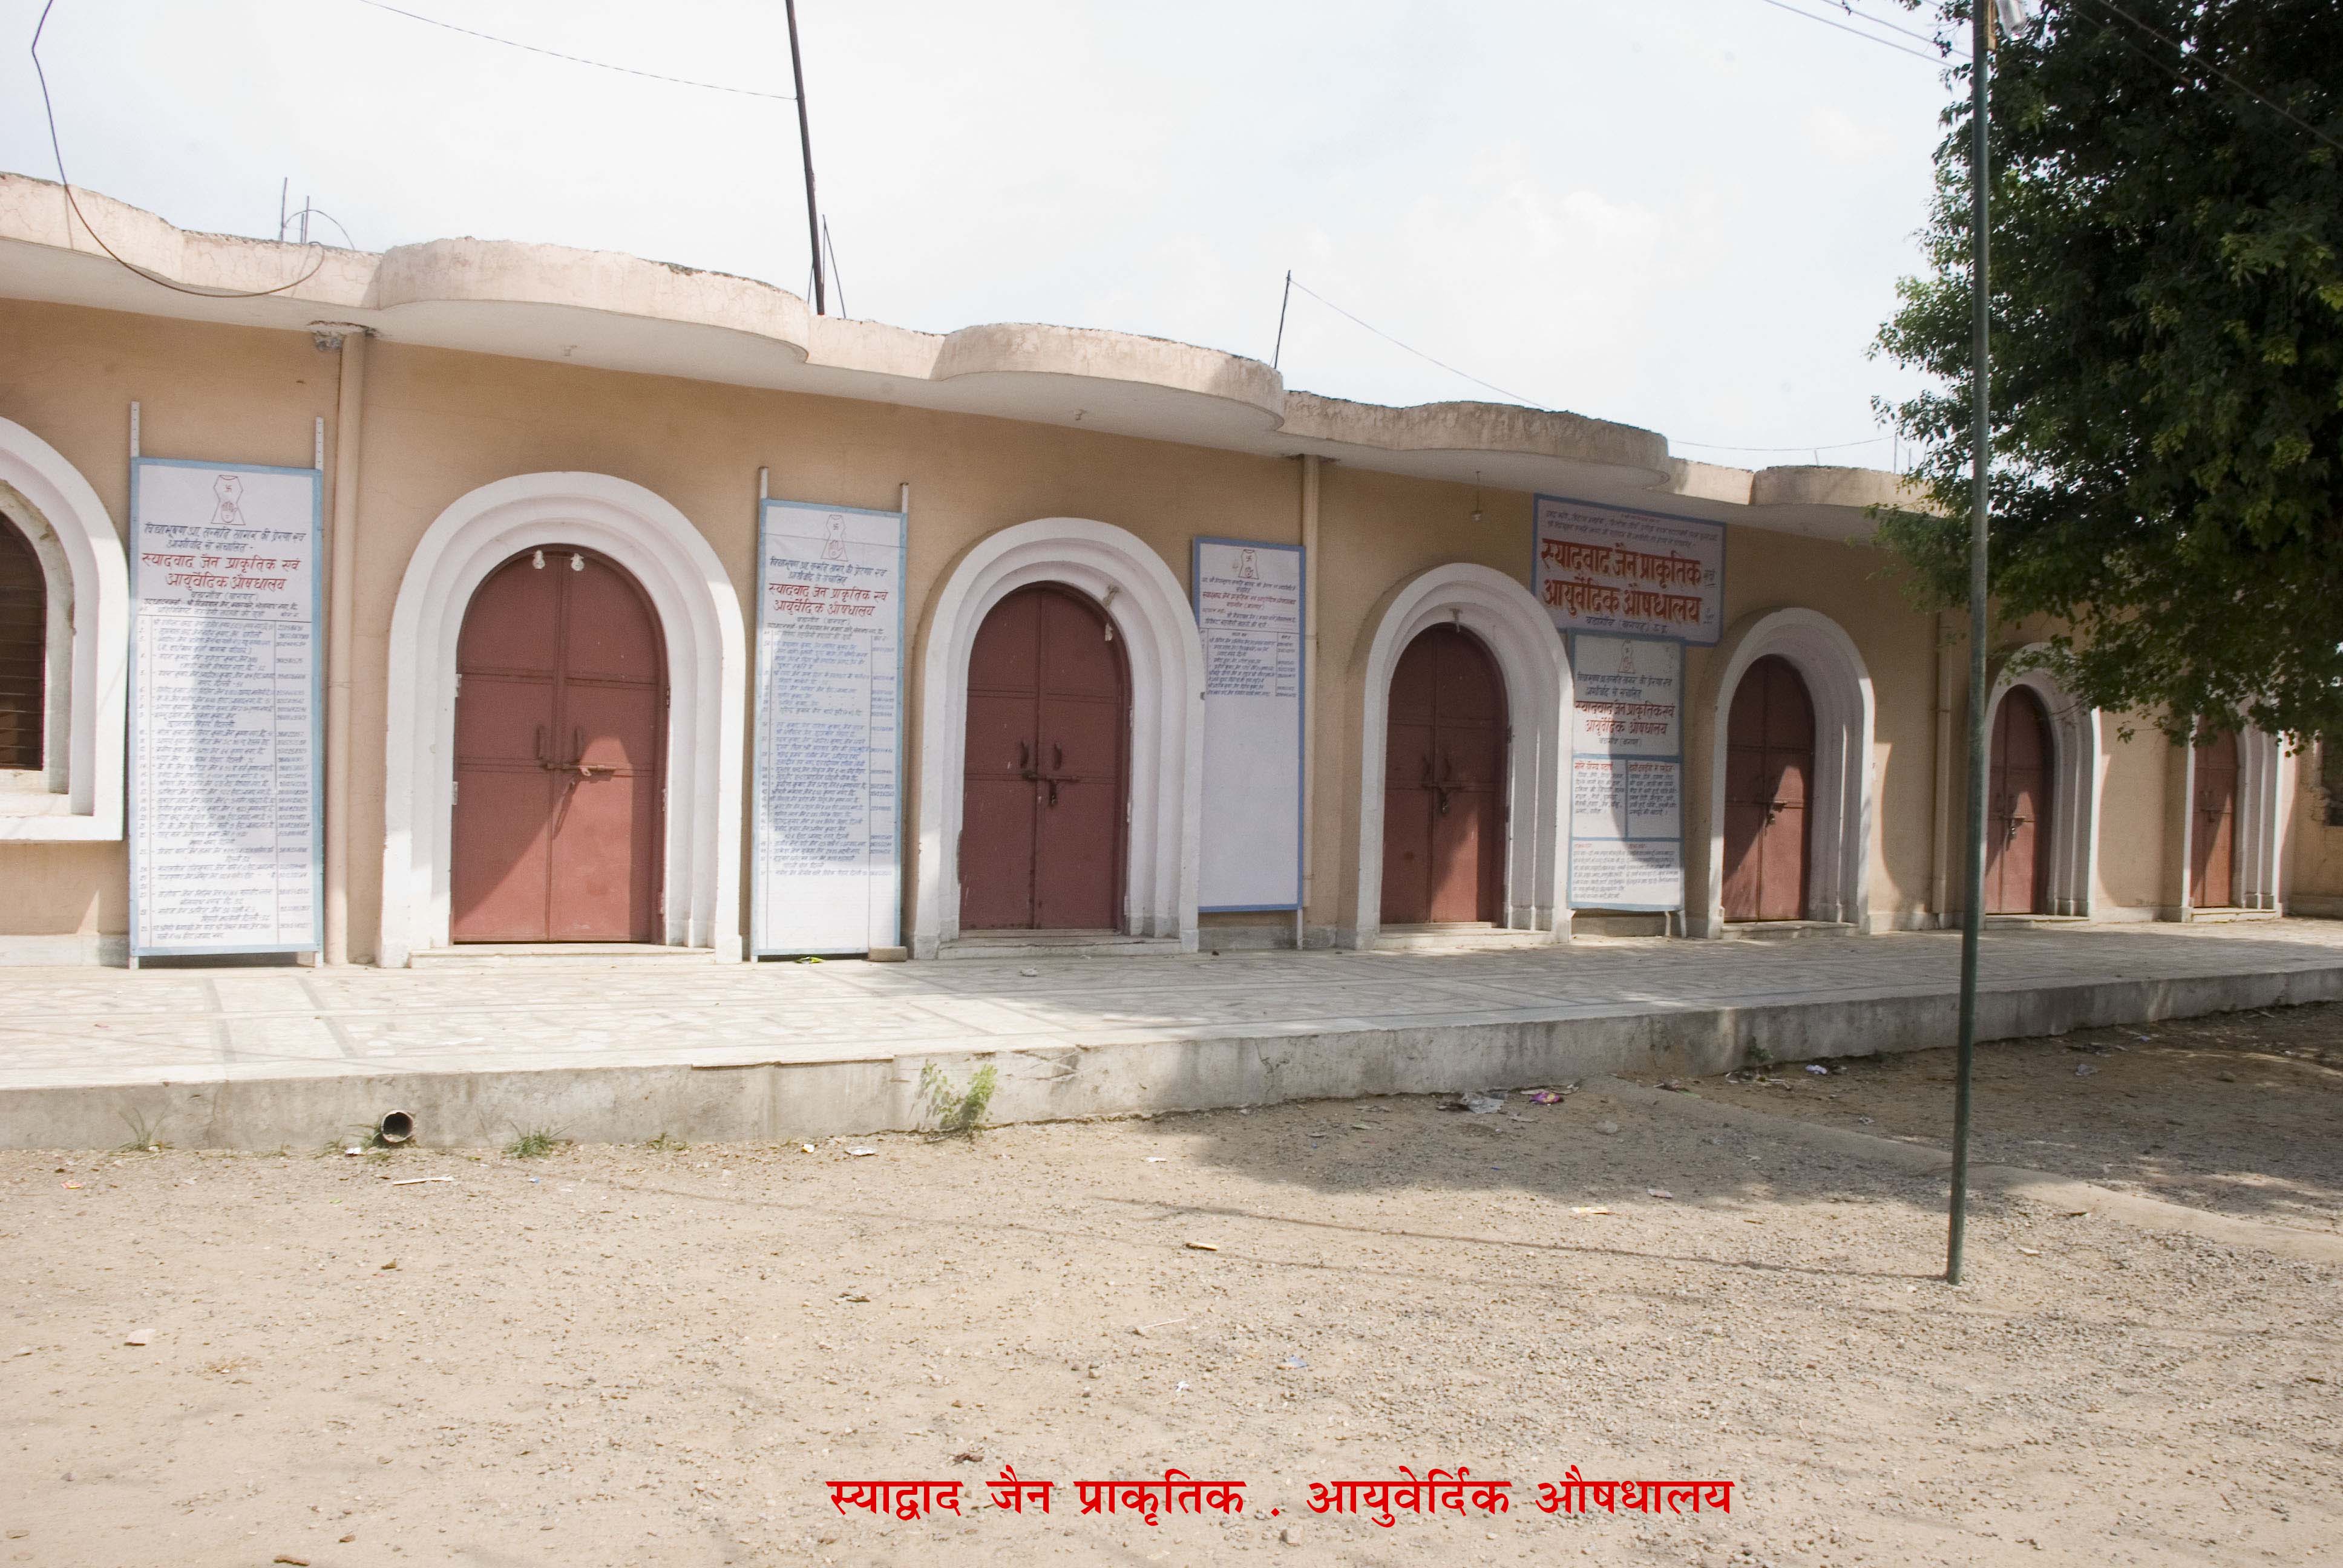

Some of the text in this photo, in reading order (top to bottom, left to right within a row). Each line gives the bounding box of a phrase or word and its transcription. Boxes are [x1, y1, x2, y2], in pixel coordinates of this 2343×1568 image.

[200, 554, 222, 569] जैन
[224, 555, 277, 572] प्राकृतिक
[1613, 542, 1638, 577] जैन
[1638, 550, 1702, 589] प्राकृतिक
[231, 575, 287, 592] औषधालय
[811, 584, 830, 598] जैन
[830, 586, 871, 602] प्राकृतिक
[1623, 583, 1702, 625] औषधालय
